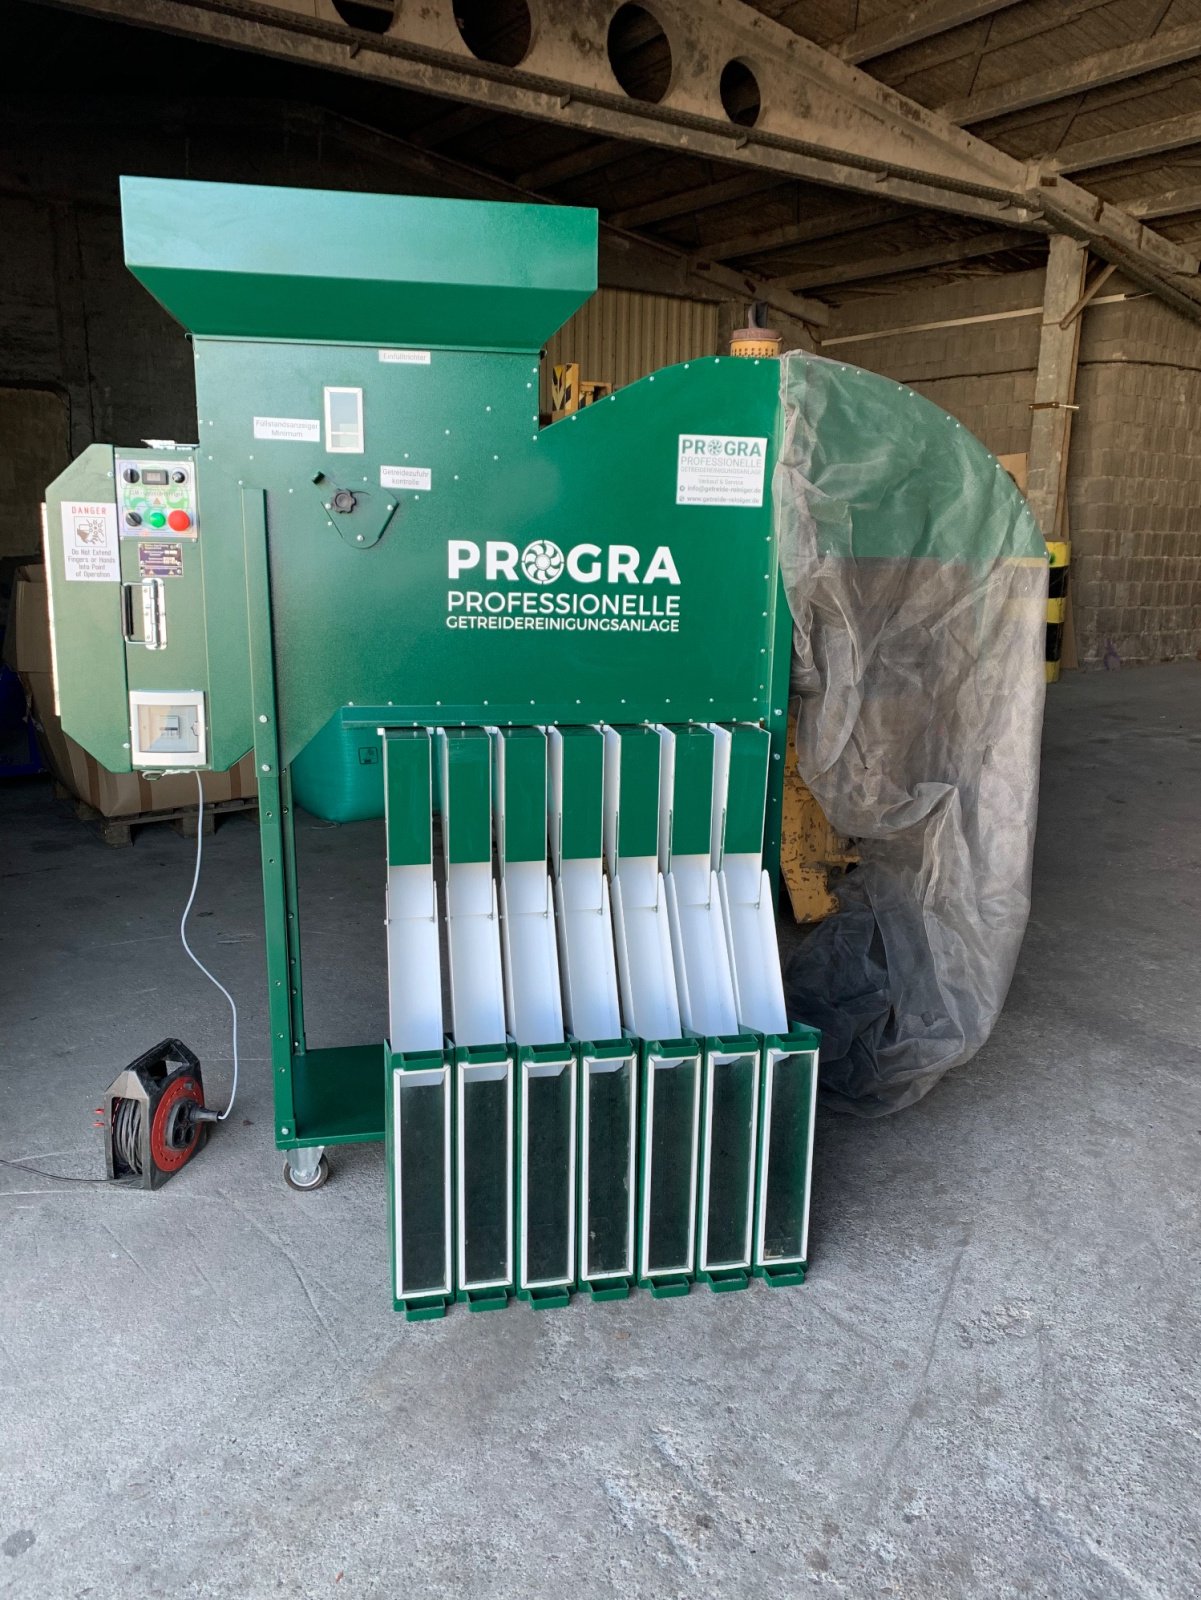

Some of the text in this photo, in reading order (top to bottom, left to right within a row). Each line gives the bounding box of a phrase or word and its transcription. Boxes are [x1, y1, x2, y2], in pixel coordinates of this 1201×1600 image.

[680, 456, 762, 468] PROFESSIONELLE
[71, 506, 107, 515] DANGER
[447, 591, 681, 616] PROFESSIONELLE
[446, 616, 680, 633] GETREIDEREINIGUNGSANLAGE
